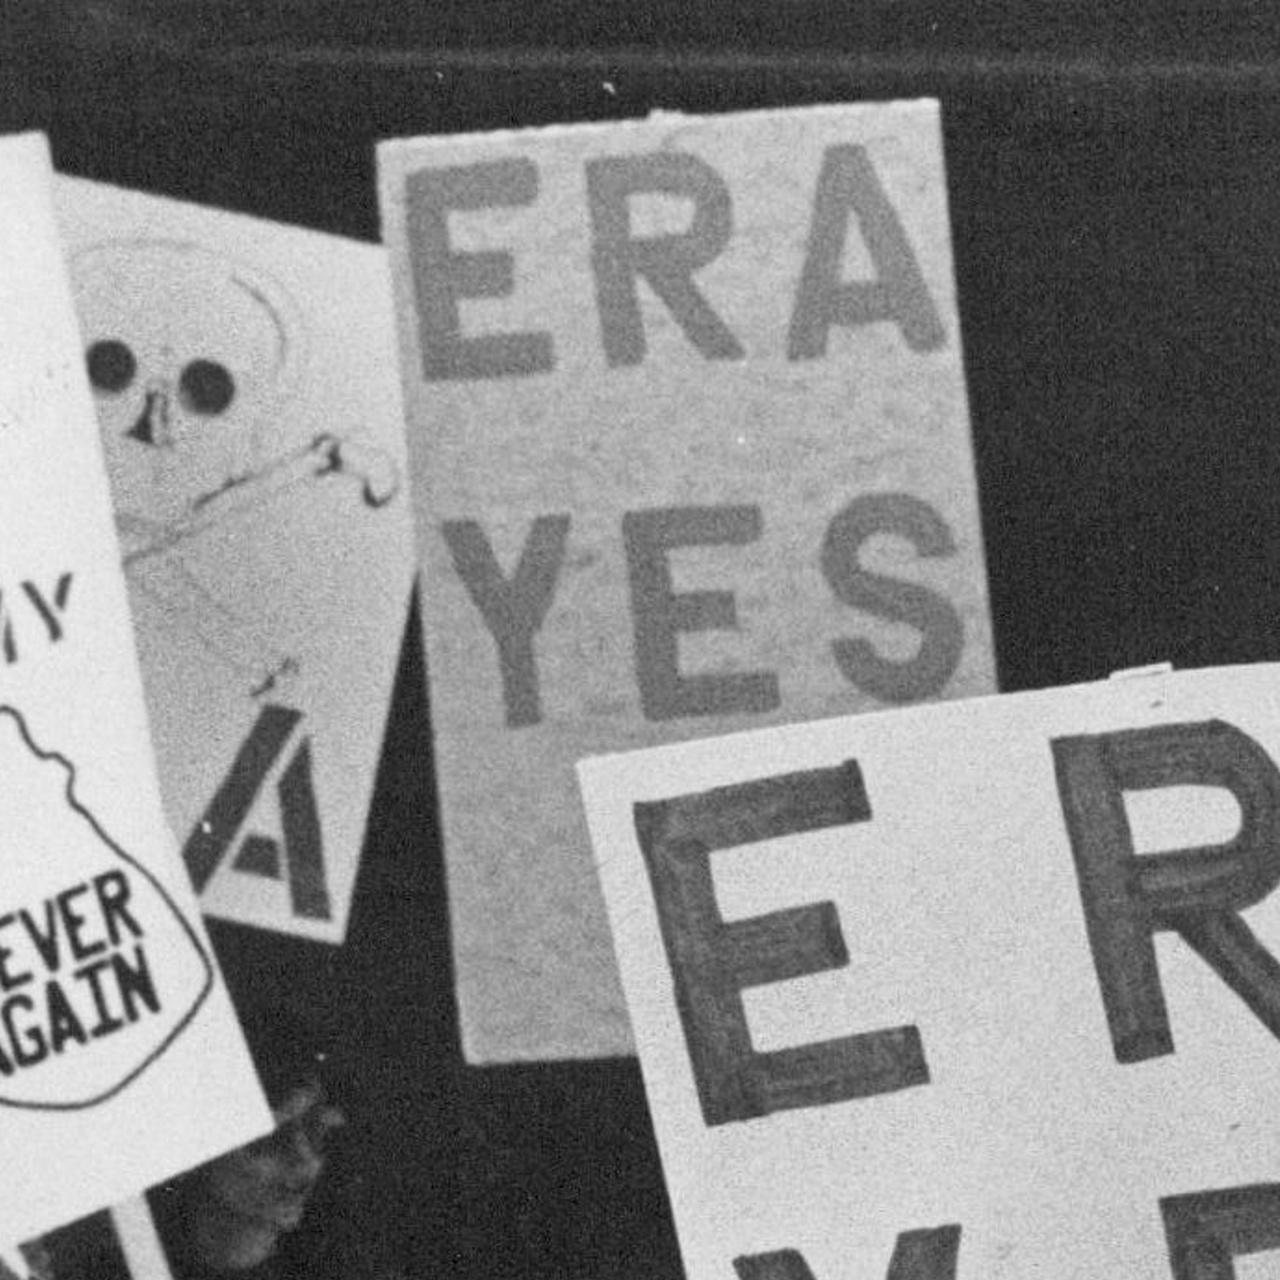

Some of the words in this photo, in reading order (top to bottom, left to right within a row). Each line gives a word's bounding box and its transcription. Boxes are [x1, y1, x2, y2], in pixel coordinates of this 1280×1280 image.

[405, 143, 946, 381] ERA
[441, 492, 963, 729] YES
[182, 702, 332, 922] A
[0, 869, 143, 991] EVER
[0, 943, 161, 1076] GAIN
